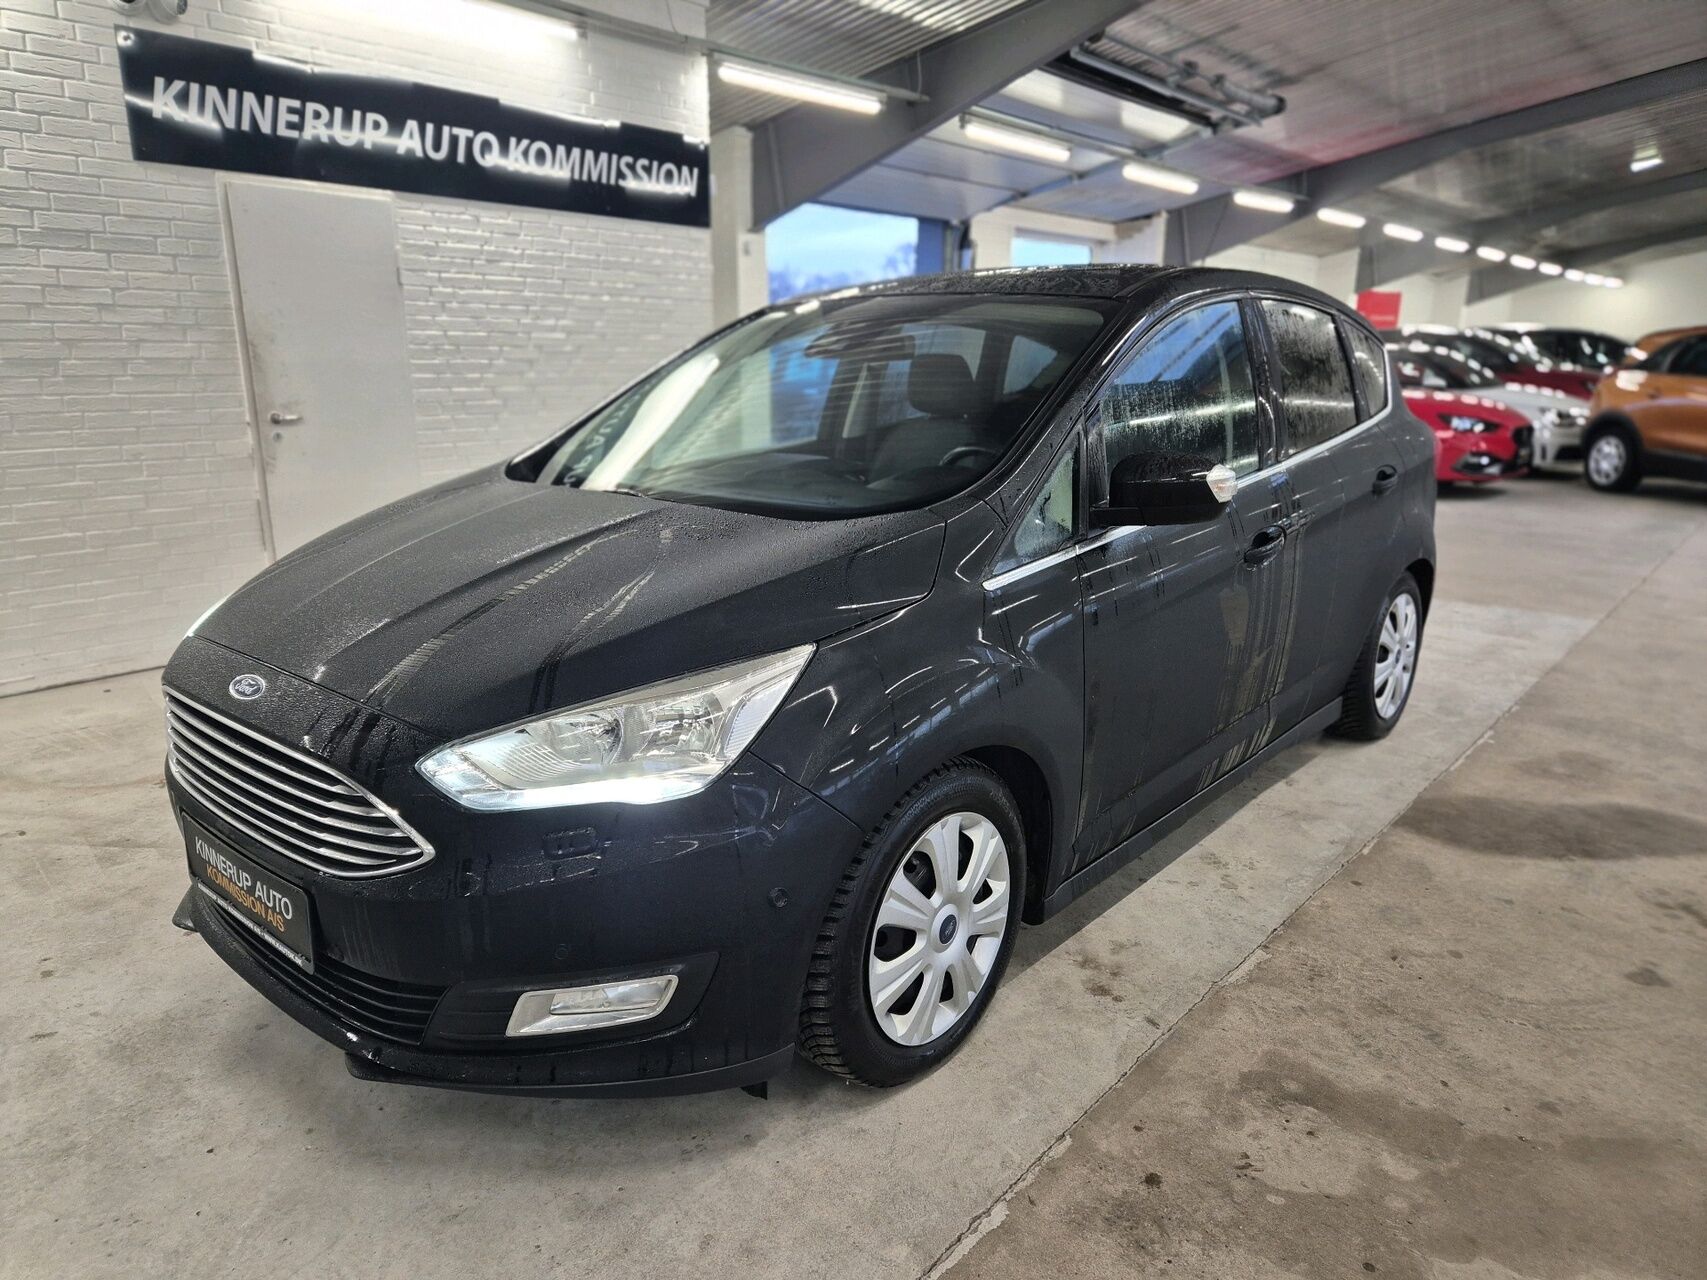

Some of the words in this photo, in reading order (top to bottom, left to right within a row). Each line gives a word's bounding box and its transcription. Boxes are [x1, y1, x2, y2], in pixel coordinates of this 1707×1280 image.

[151, 75, 389, 151] KINNERUP
[396, 118, 501, 168] AUTO
[507, 136, 699, 197] KOMMISSION
[195, 836, 252, 891] KINNERUP
[255, 880, 293, 920] AUTO
[206, 863, 266, 918] KOMMISSION
